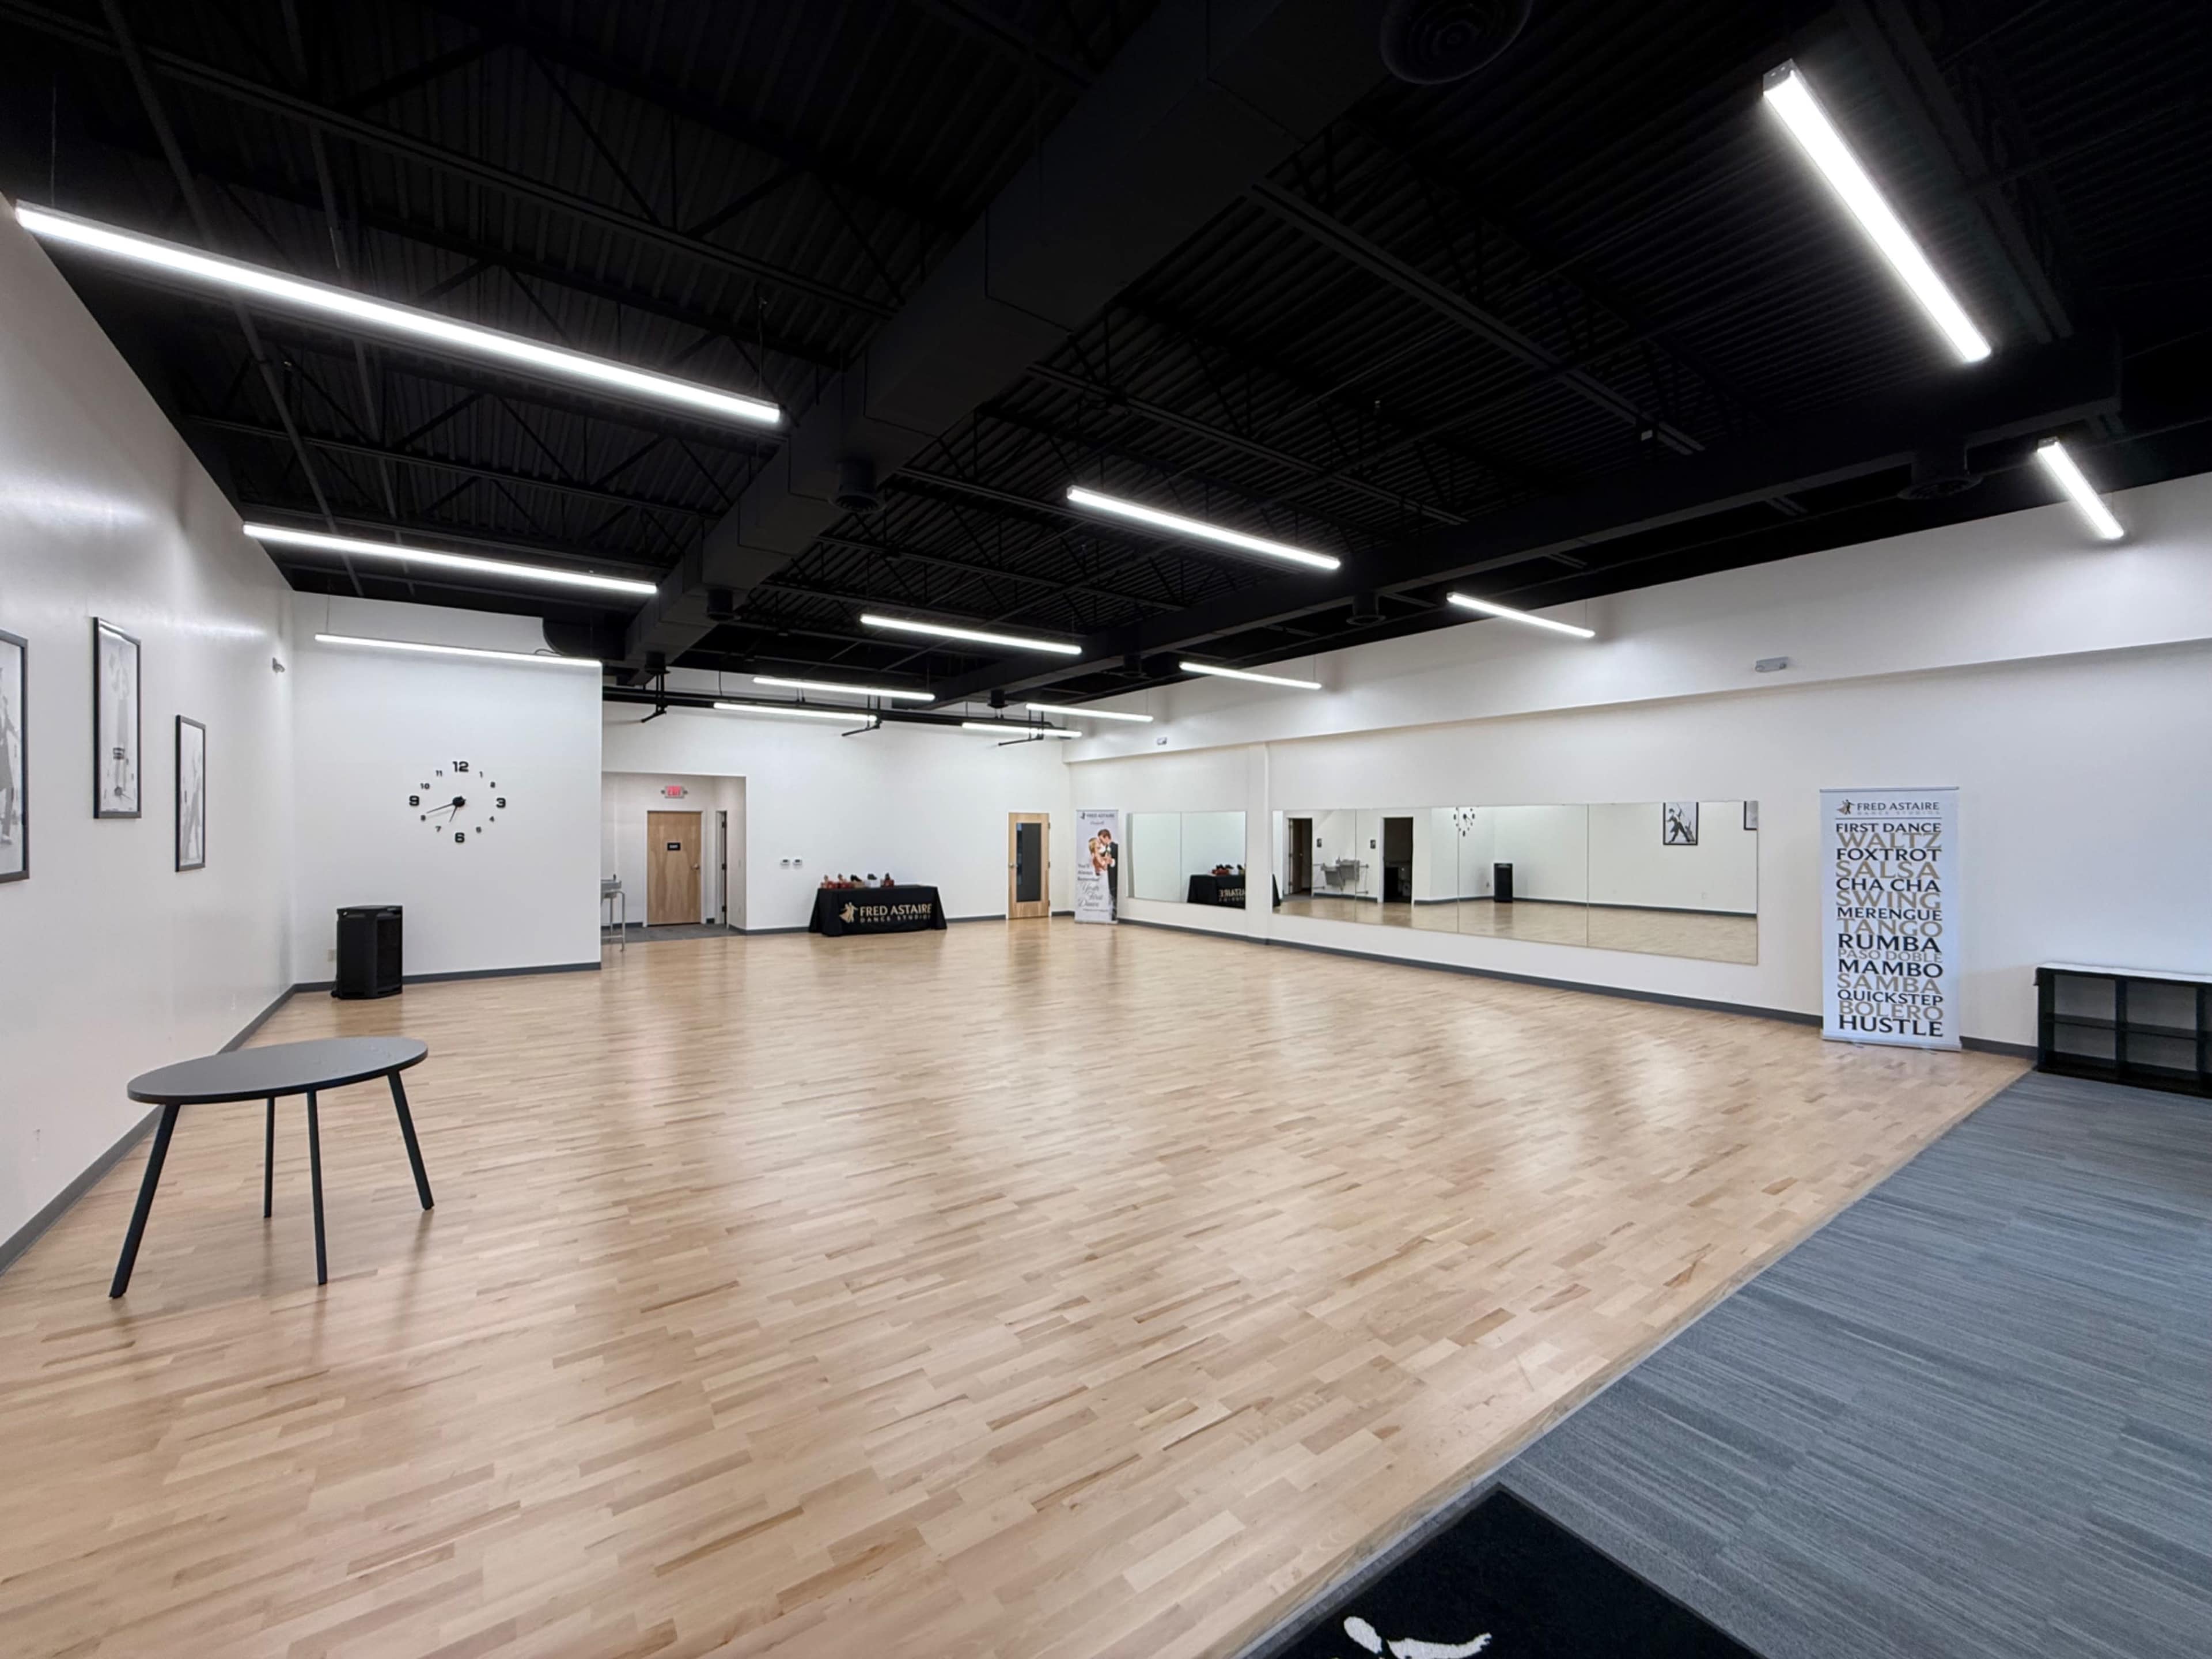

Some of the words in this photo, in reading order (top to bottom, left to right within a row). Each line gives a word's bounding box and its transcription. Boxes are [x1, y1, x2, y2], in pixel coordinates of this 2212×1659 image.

[453, 761, 469, 772] 12
[409, 795, 420, 806] 9
[496, 797, 506, 808] 3
[1857, 802, 1885, 810] FRED
[1889, 802, 1940, 810] ASTAIRE
[1836, 823, 1879, 832] FIRST
[1883, 823, 1942, 832] DANCE
[454, 832, 465, 843] 6
[1836, 831, 1942, 848] WALTZ
[1836, 848, 1942, 862] FOXTROT
[1836, 860, 1940, 880] SALSA
[1836, 877, 1884, 891] CHA
[1890, 878, 1941, 892] CHA
[1836, 890, 1941, 910] SWING
[860, 905, 888, 916] FRED
[890, 903, 931, 915] ASTAIRE
[1837, 907, 1942, 921] MERENGUE
[1836, 918, 1943, 938] TANGO
[1838, 933, 1941, 953] RUMBA
[1838, 949, 1881, 960] PASO
[1885, 950, 1943, 963] DOBLE
[1838, 959, 1943, 978] MAMBO
[1837, 973, 1942, 994] SAMBA
[1838, 989, 1944, 1006] QUICKSTEP
[1839, 1000, 1944, 1021] BOLERO
[1839, 1014, 1943, 1037] HUSTLE
